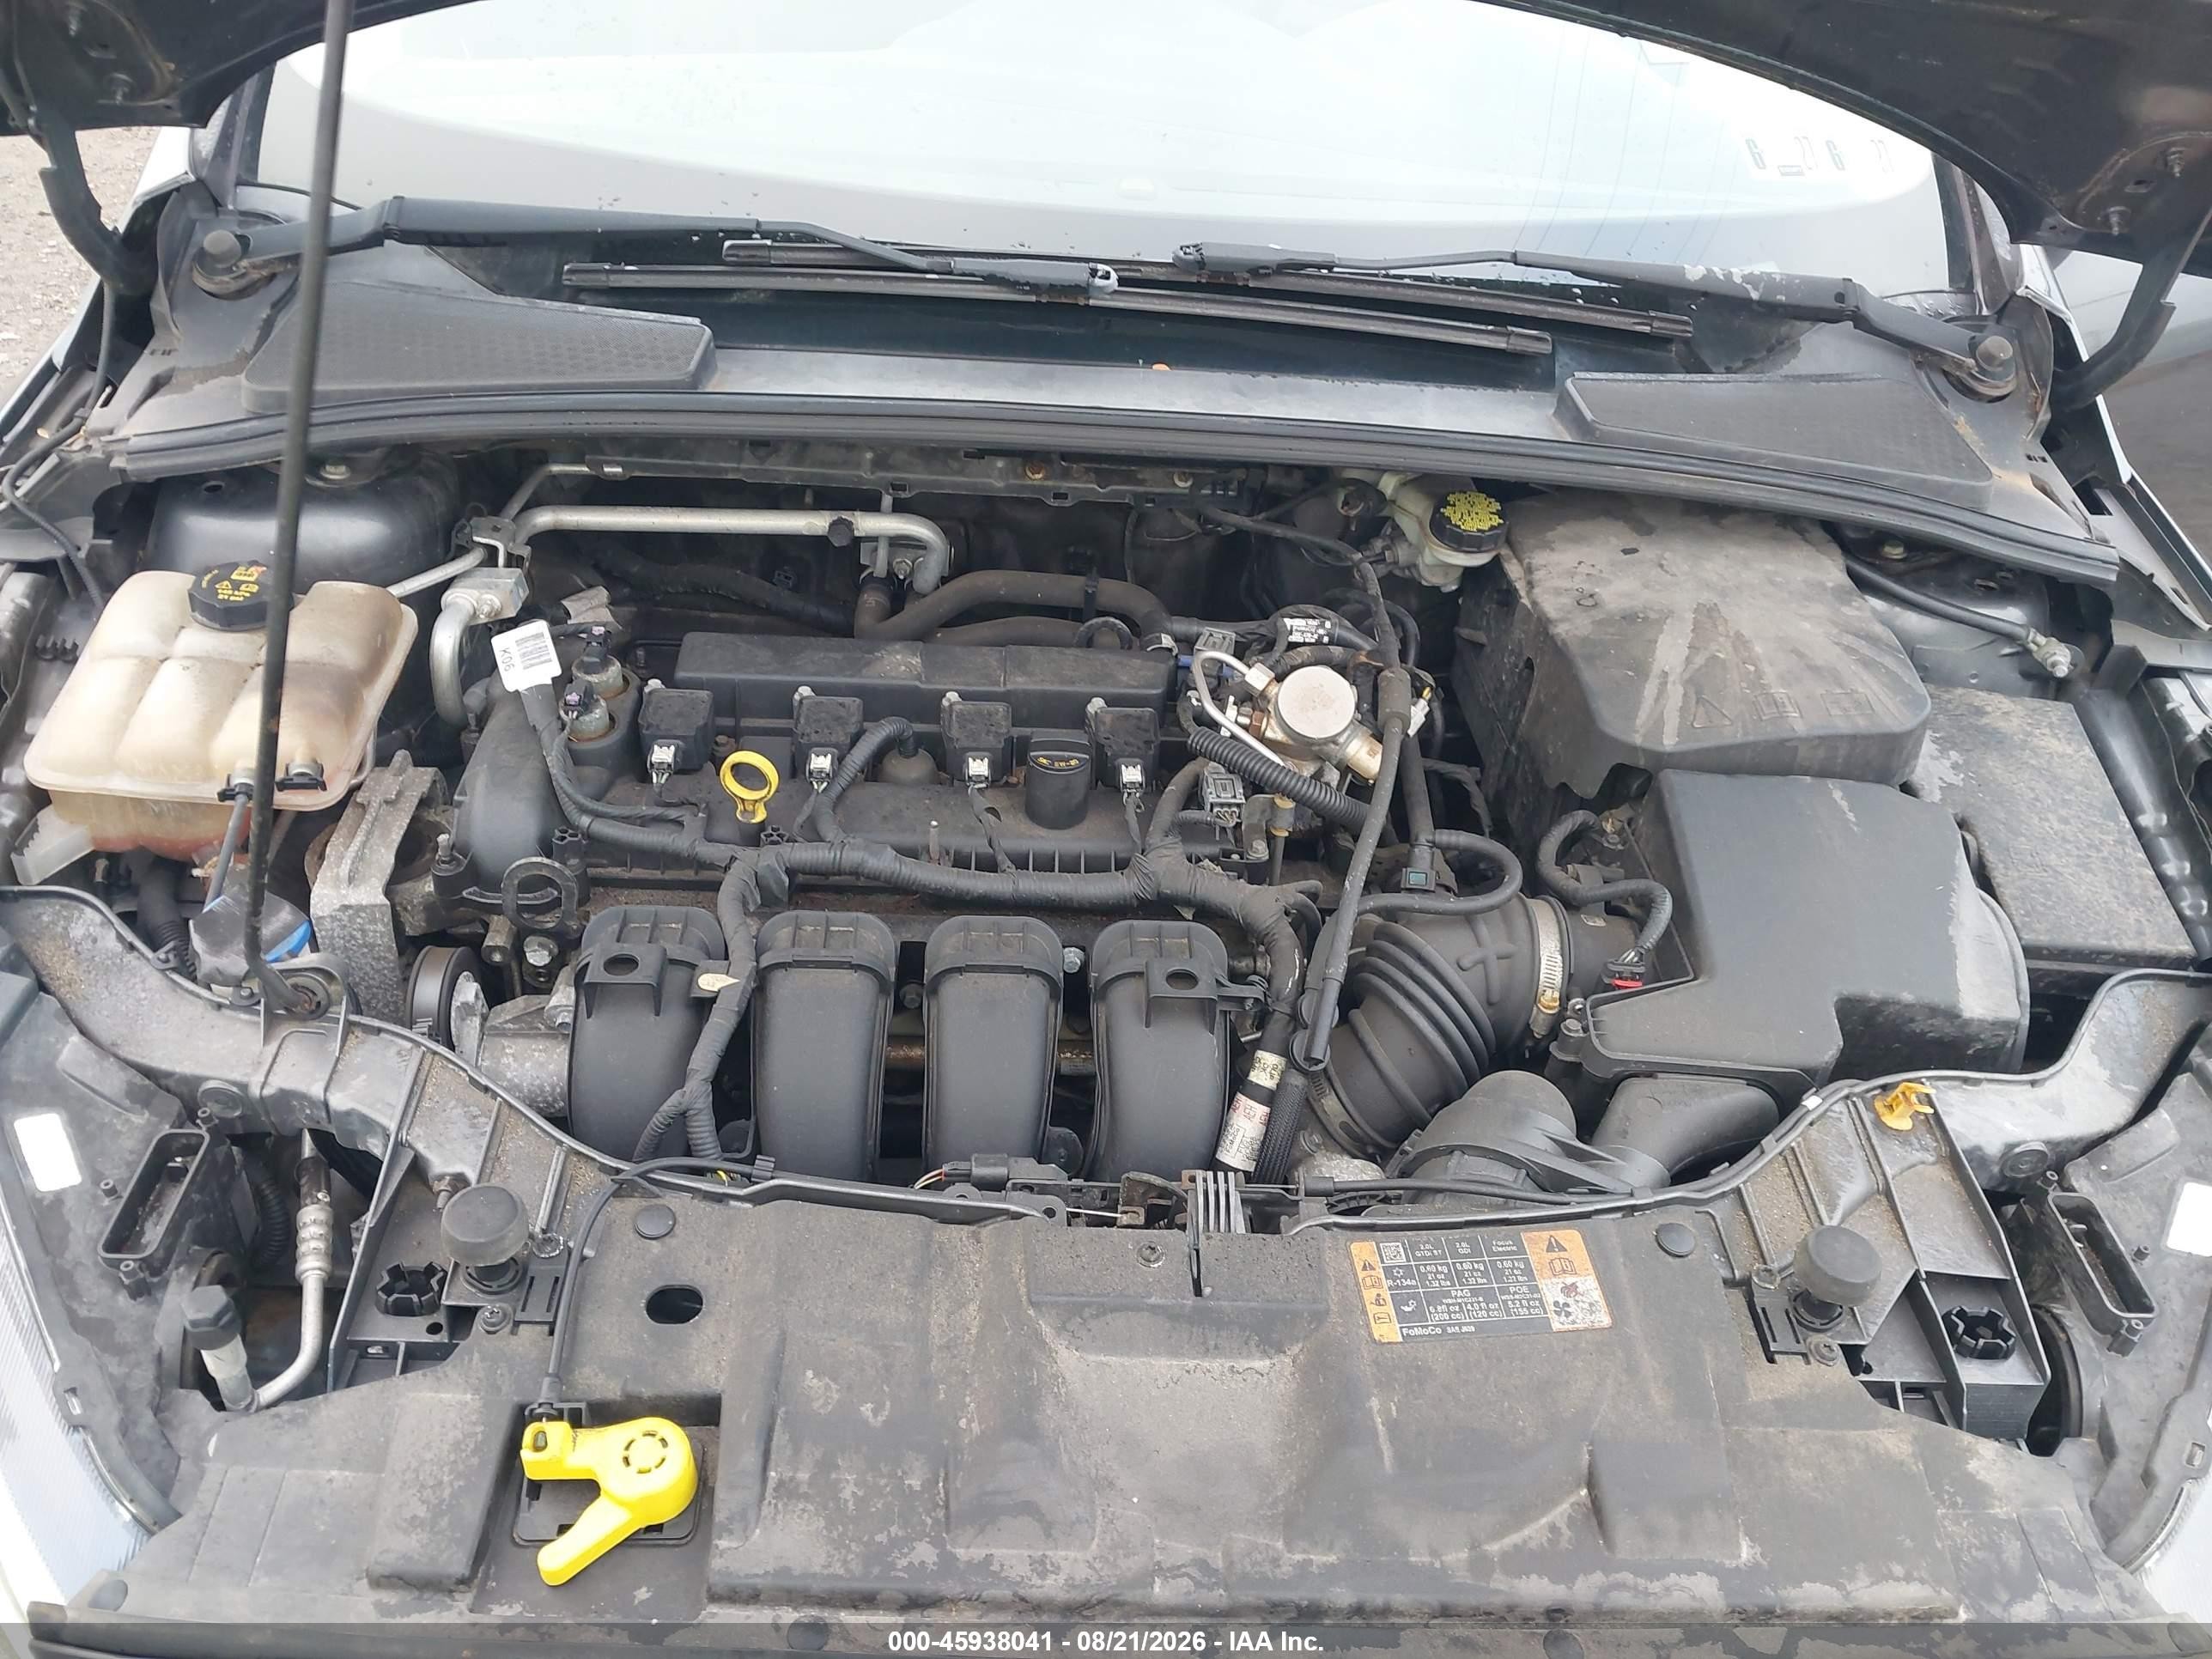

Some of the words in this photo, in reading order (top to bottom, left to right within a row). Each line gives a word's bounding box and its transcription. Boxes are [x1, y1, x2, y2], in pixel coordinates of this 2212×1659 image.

[500, 647, 515, 672] K06
[1419, 1265, 1437, 1273] 0.60
[1437, 1264, 1449, 1273] kg
[1456, 1262, 1473, 1270] 0.60
[1474, 1261, 1485, 1271] kg
[1514, 1260, 1525, 1269] kg
[1387, 1279, 1417, 1288] R-134a
[1431, 1313, 1449, 1322] (200
[1451, 1312, 1464, 1321] cc)
[1469, 1310, 1489, 1320] (120
[1491, 1310, 1503, 1318] cc)
[1511, 1308, 1529, 1317] (155
[1531, 1307, 1544, 1315] cc)
[1402, 1327, 1442, 1337] FoMoCo
